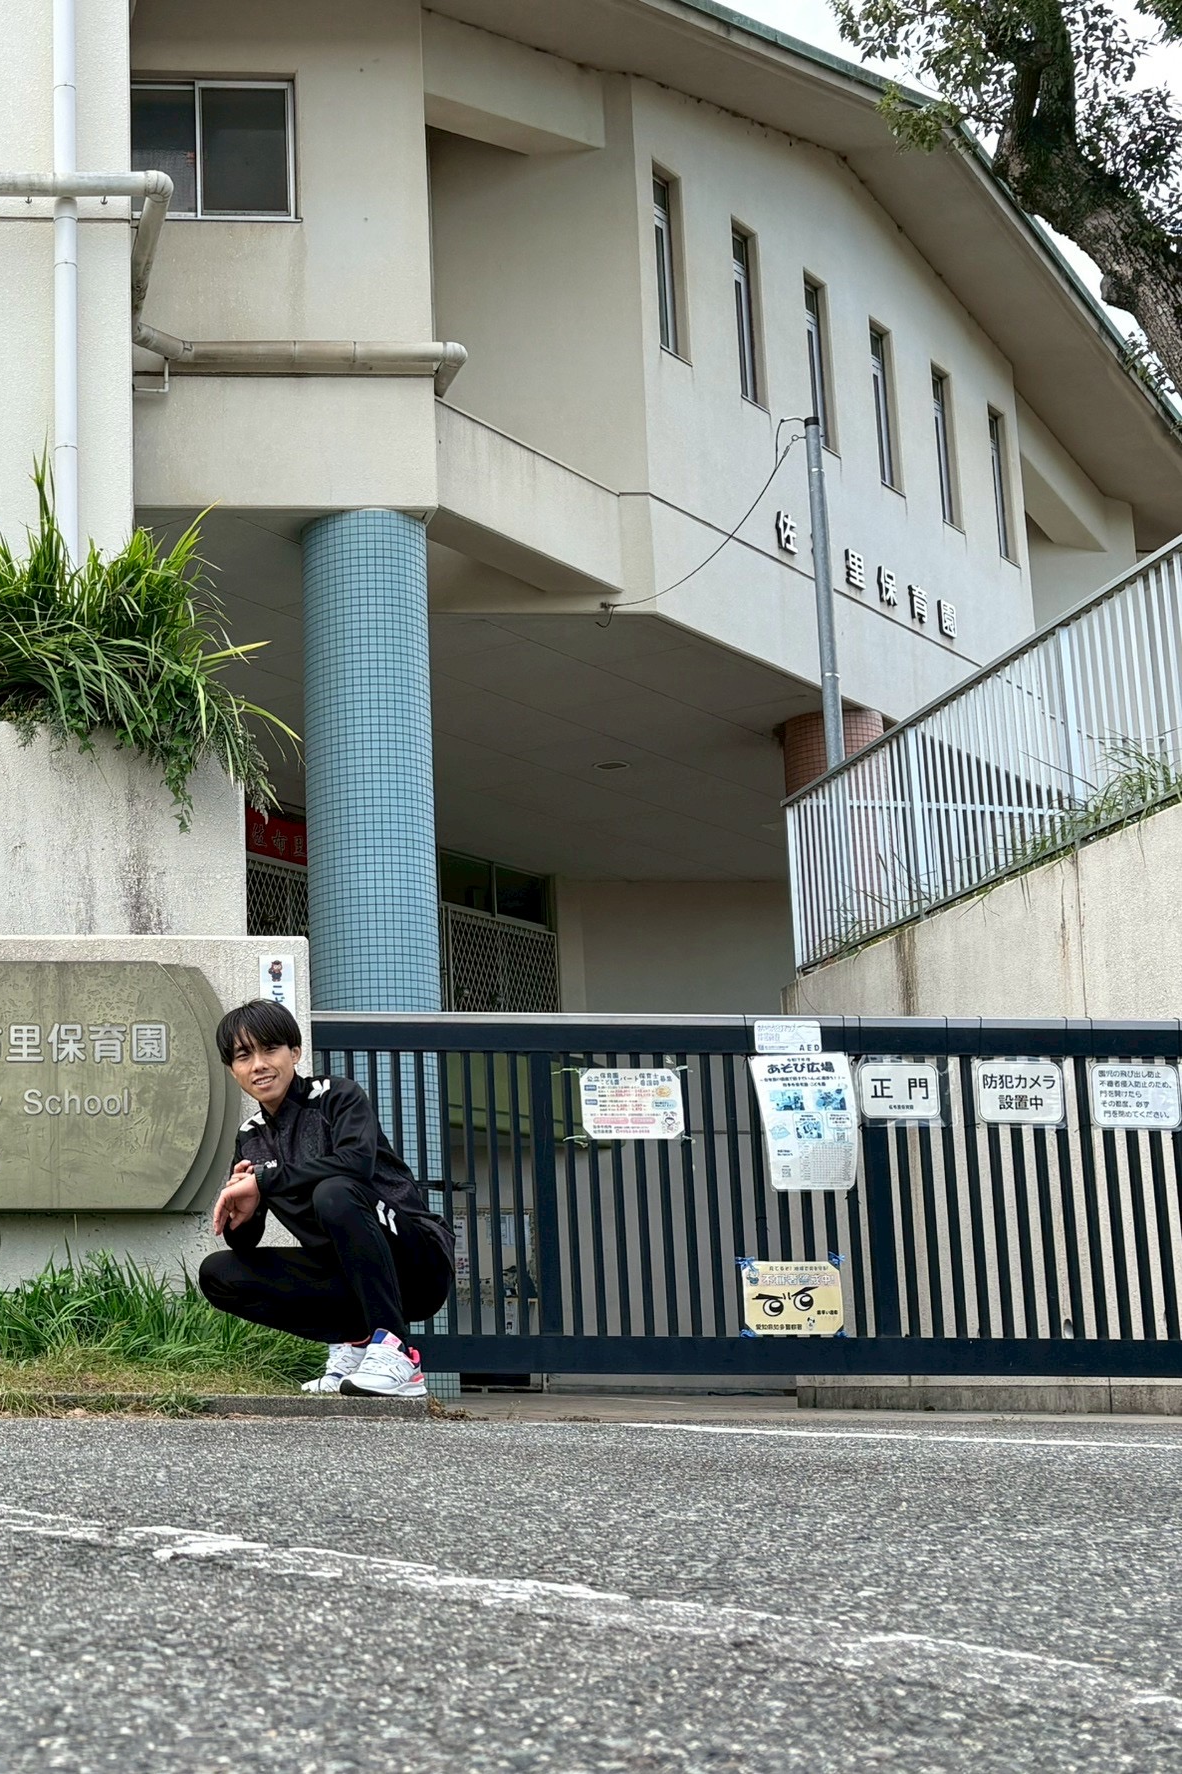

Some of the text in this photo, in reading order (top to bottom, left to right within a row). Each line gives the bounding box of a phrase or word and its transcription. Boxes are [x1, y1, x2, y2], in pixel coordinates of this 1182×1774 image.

[775, 510, 957, 638] 佐里保育園
[767, 1061, 835, 1074] あそび広場
[1098, 1069, 1162, 1079] 園児の飛び出し防止
[870, 1078, 929, 1100] 正門
[982, 1074, 1056, 1090] 防犯カメラ
[1099, 1090, 1142, 1098] 門を開けたら
[23, 1089, 130, 1116] School
[998, 1094, 1044, 1111] 設置中
